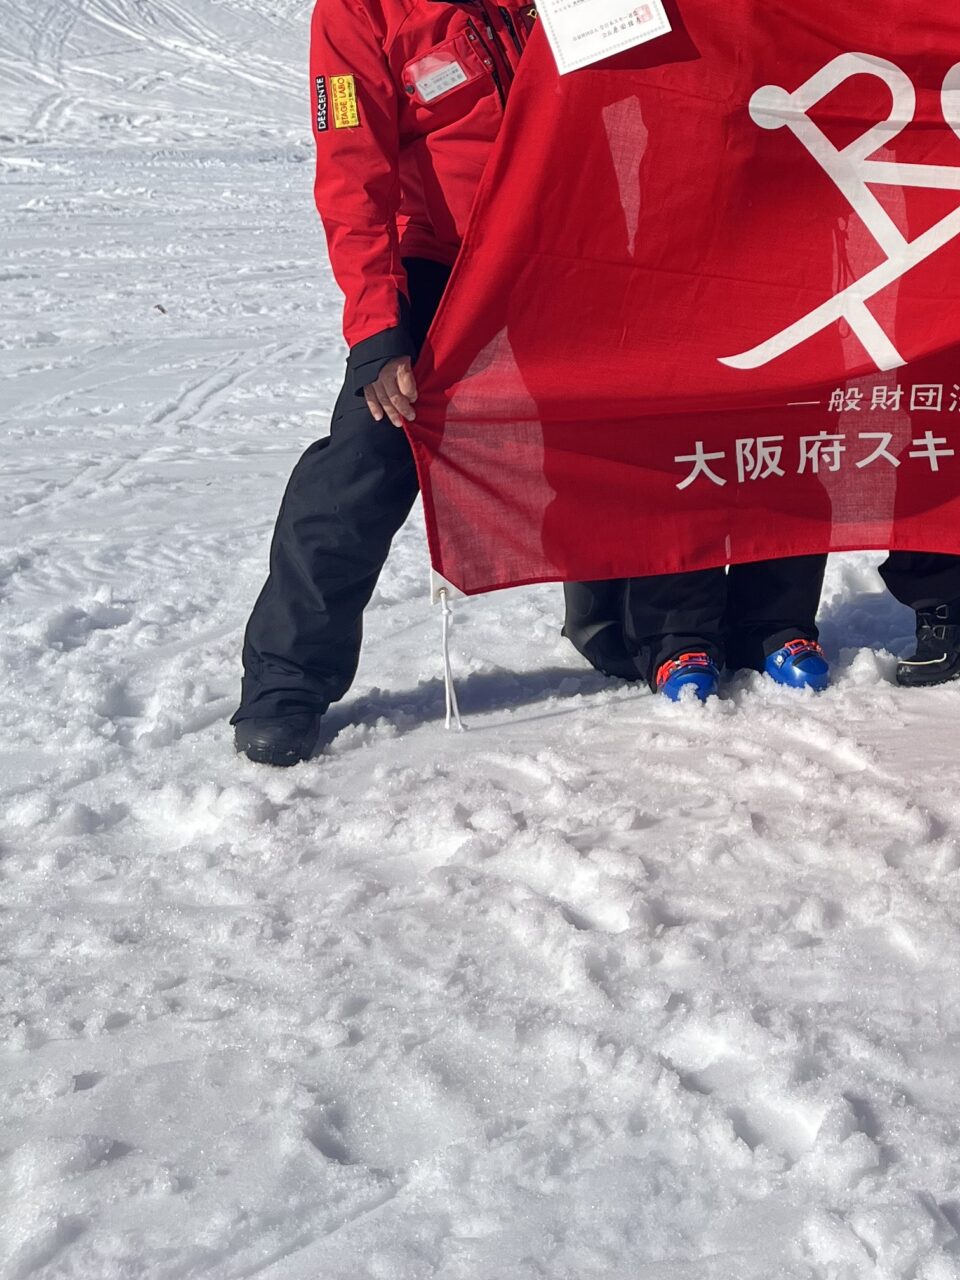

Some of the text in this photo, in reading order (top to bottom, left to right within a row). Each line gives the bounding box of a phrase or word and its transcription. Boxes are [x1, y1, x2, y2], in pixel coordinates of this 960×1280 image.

[316, 77, 327, 130] DESCENTE
[337, 77, 350, 125] STAGE LABO
